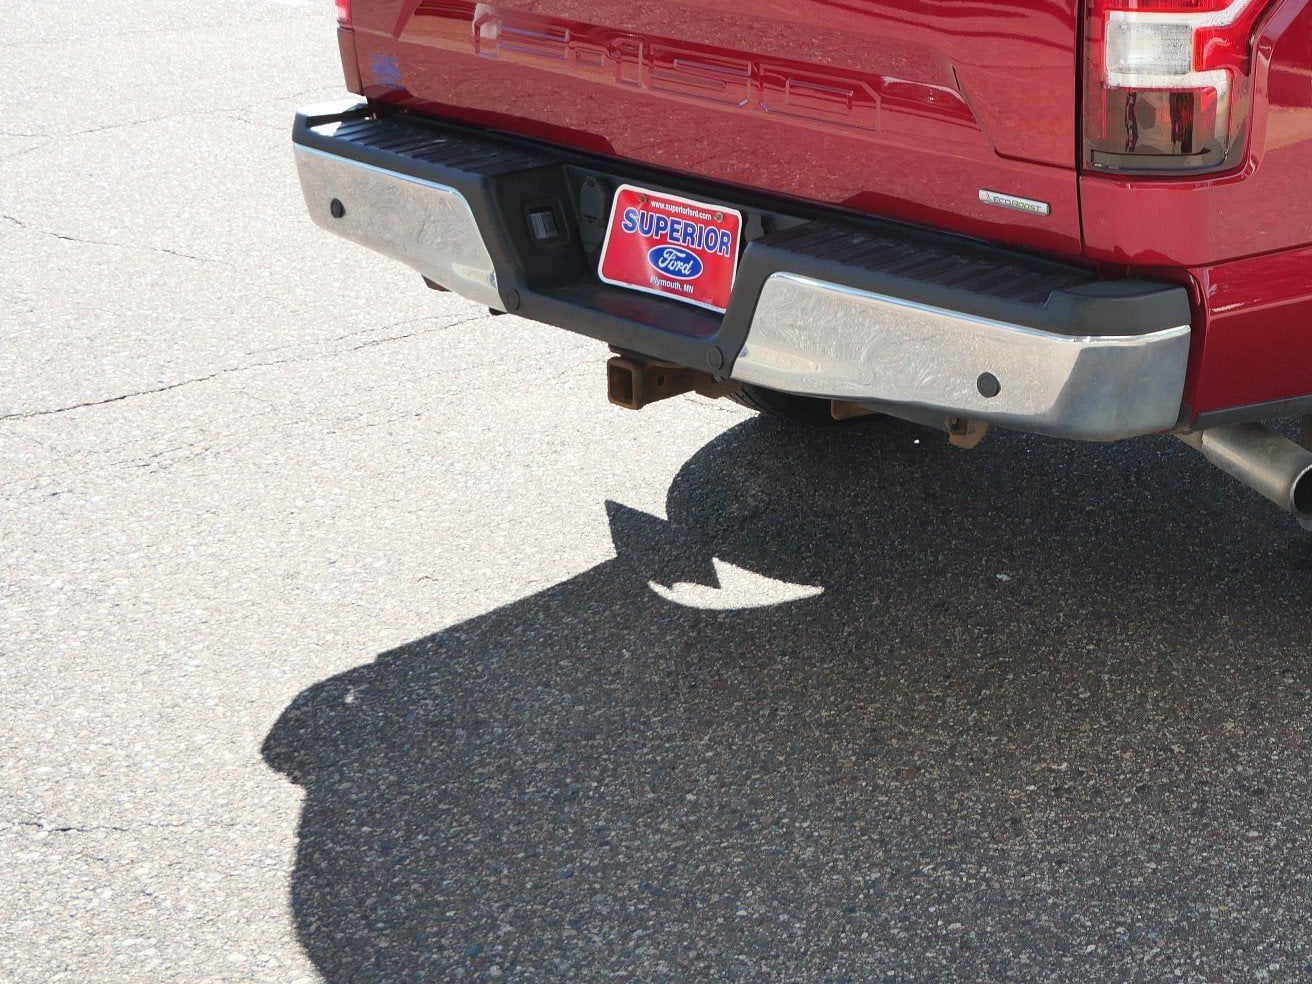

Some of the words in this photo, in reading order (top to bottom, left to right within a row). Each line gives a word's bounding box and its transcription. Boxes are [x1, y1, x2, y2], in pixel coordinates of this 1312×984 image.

[650, 200, 712, 221] www.superiorford.com
[621, 207, 732, 257] SUPERIOR
[658, 248, 694, 275] Ford
[650, 275, 682, 292] Plymouth,
[683, 283, 694, 294] MN
